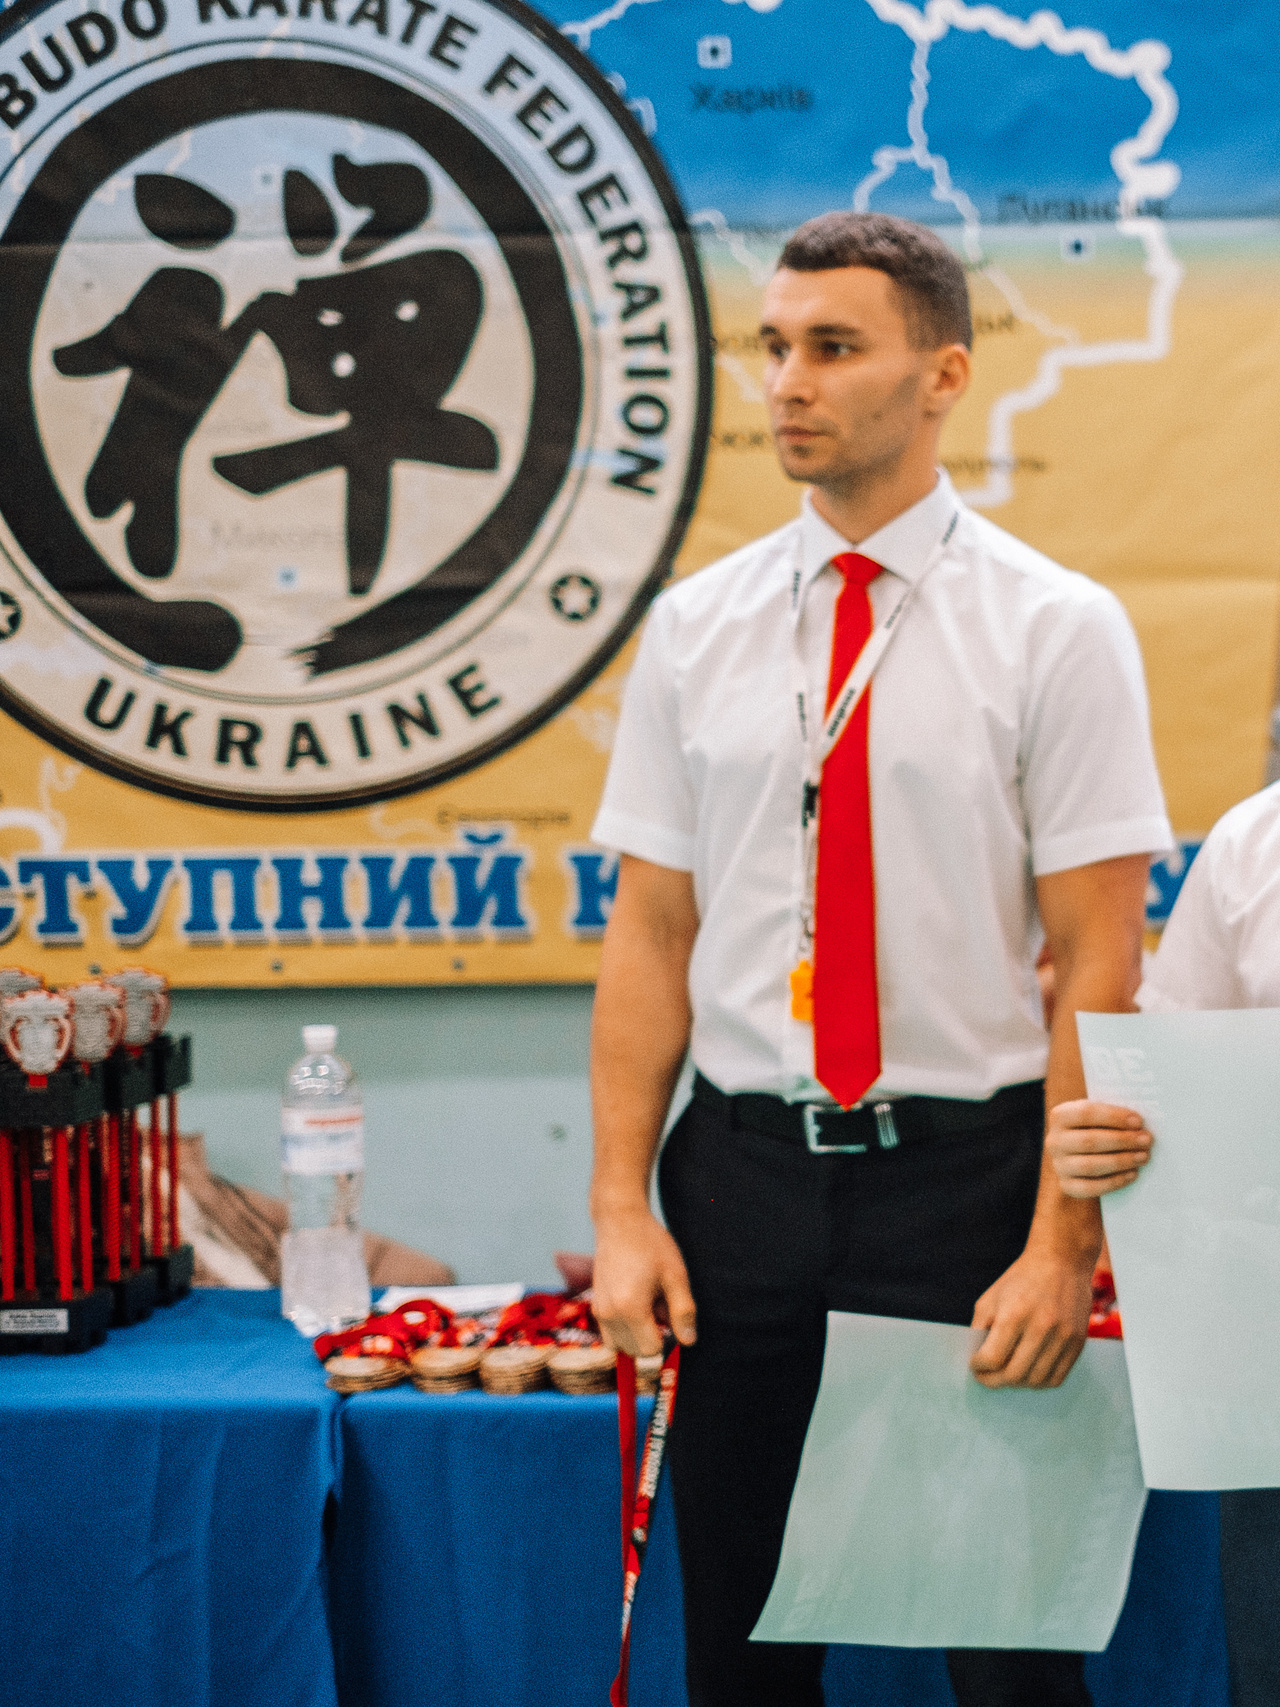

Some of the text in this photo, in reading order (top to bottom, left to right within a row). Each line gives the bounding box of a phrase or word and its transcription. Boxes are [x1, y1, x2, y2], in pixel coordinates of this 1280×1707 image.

[0, 0, 167, 130] BUDO
[482, 52, 671, 495] FEDERATION
[82, 662, 500, 769] UKRAINE
[0, 832, 528, 938] ТУПНИЙ
